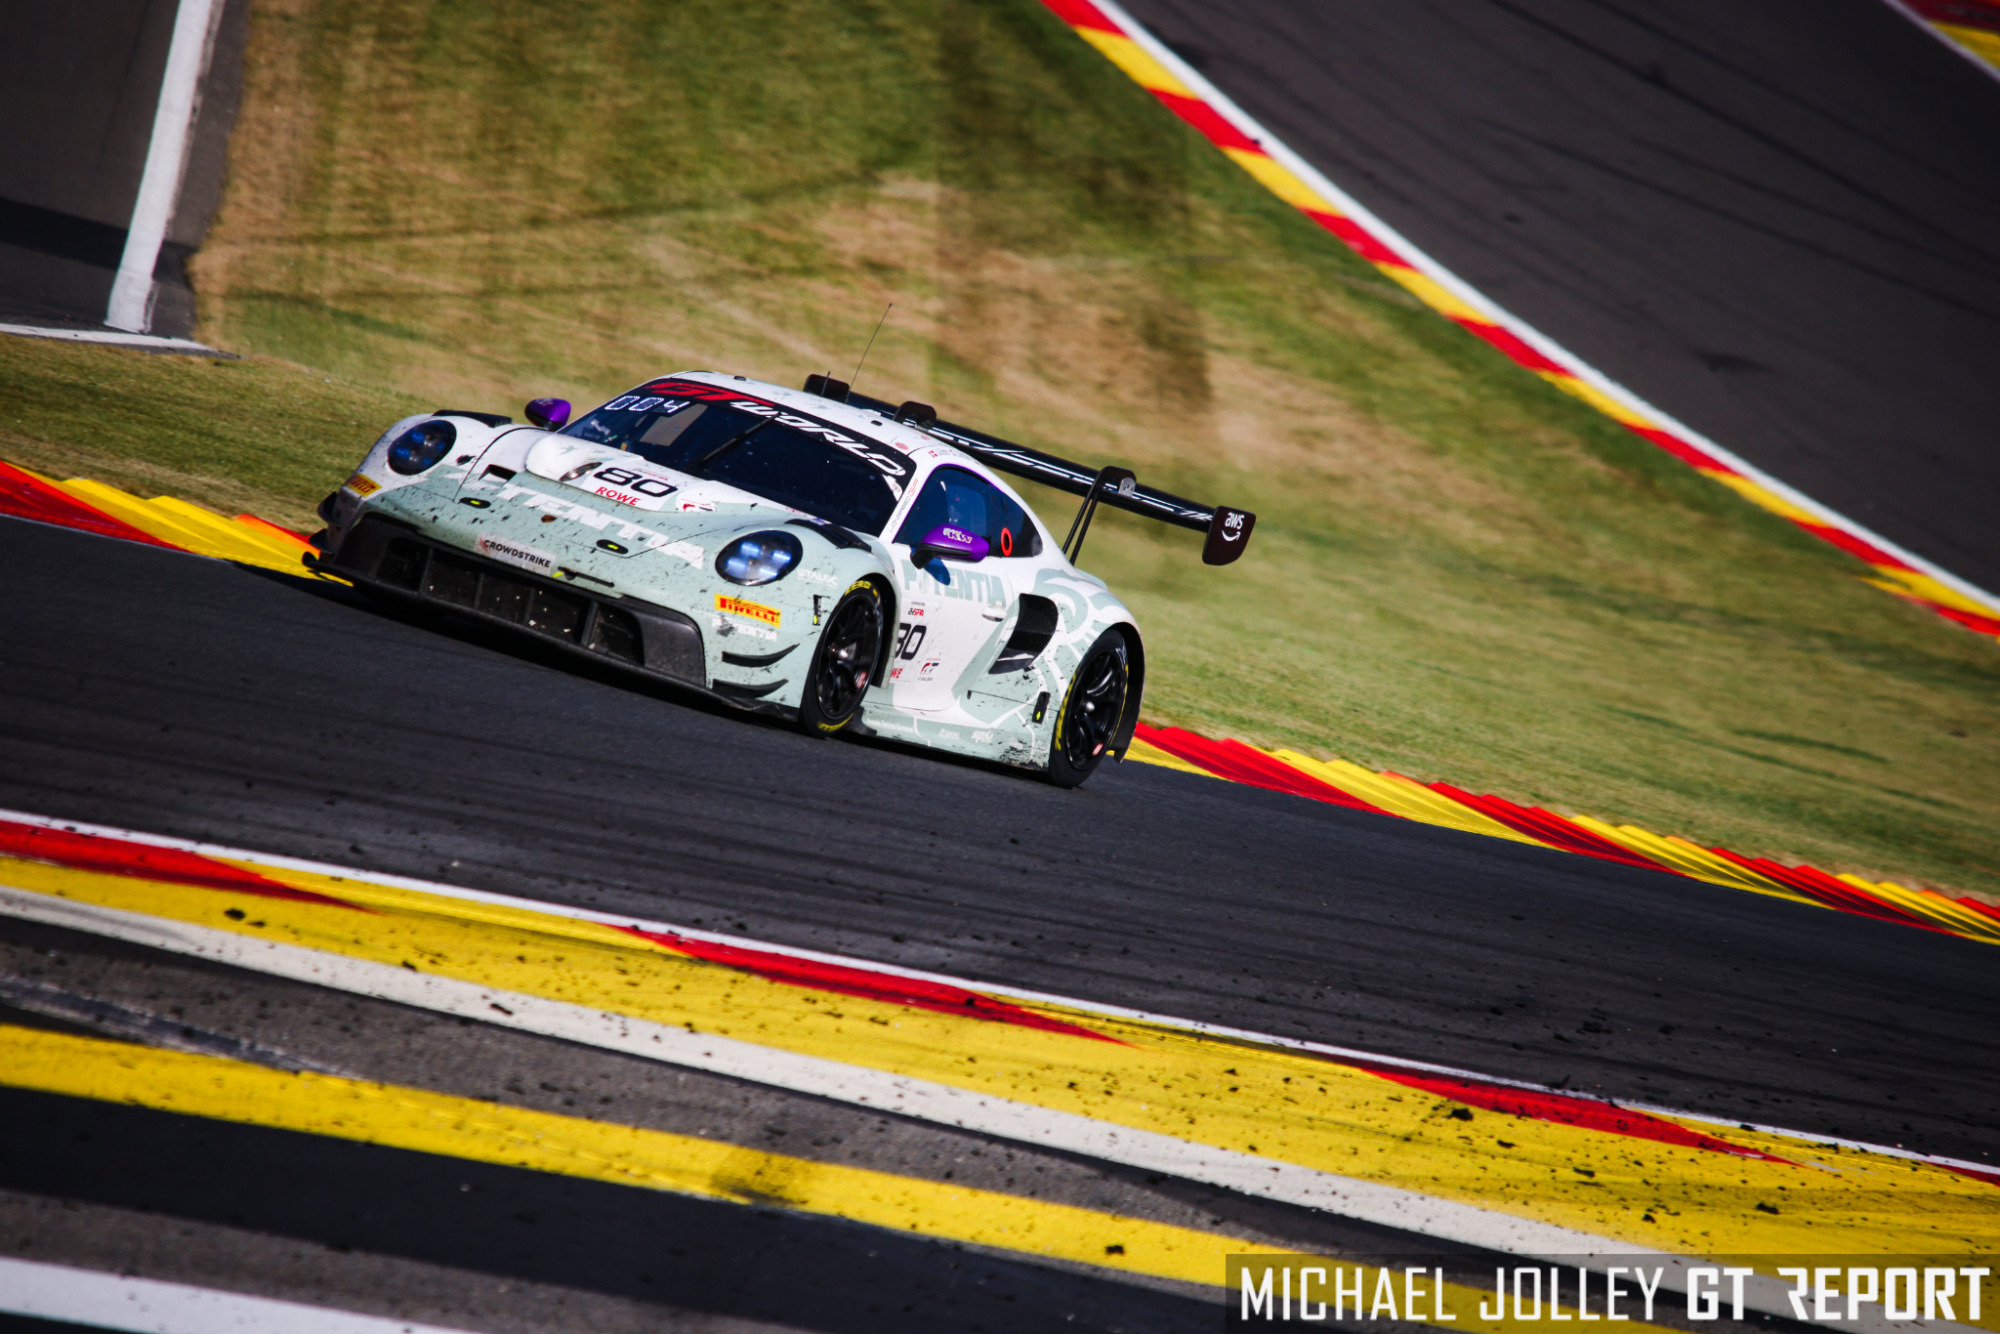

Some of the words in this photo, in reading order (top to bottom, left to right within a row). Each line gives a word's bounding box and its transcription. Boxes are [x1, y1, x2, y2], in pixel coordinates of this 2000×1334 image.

[604, 395, 691, 413] 004
[730, 401, 906, 476] WORLD
[594, 467, 679, 498] 80
[595, 486, 641, 506] ROWE
[1224, 512, 1245, 530] aws
[483, 539, 552, 569] CROWDSTRIKE
[719, 597, 776, 623] PIRELLI
